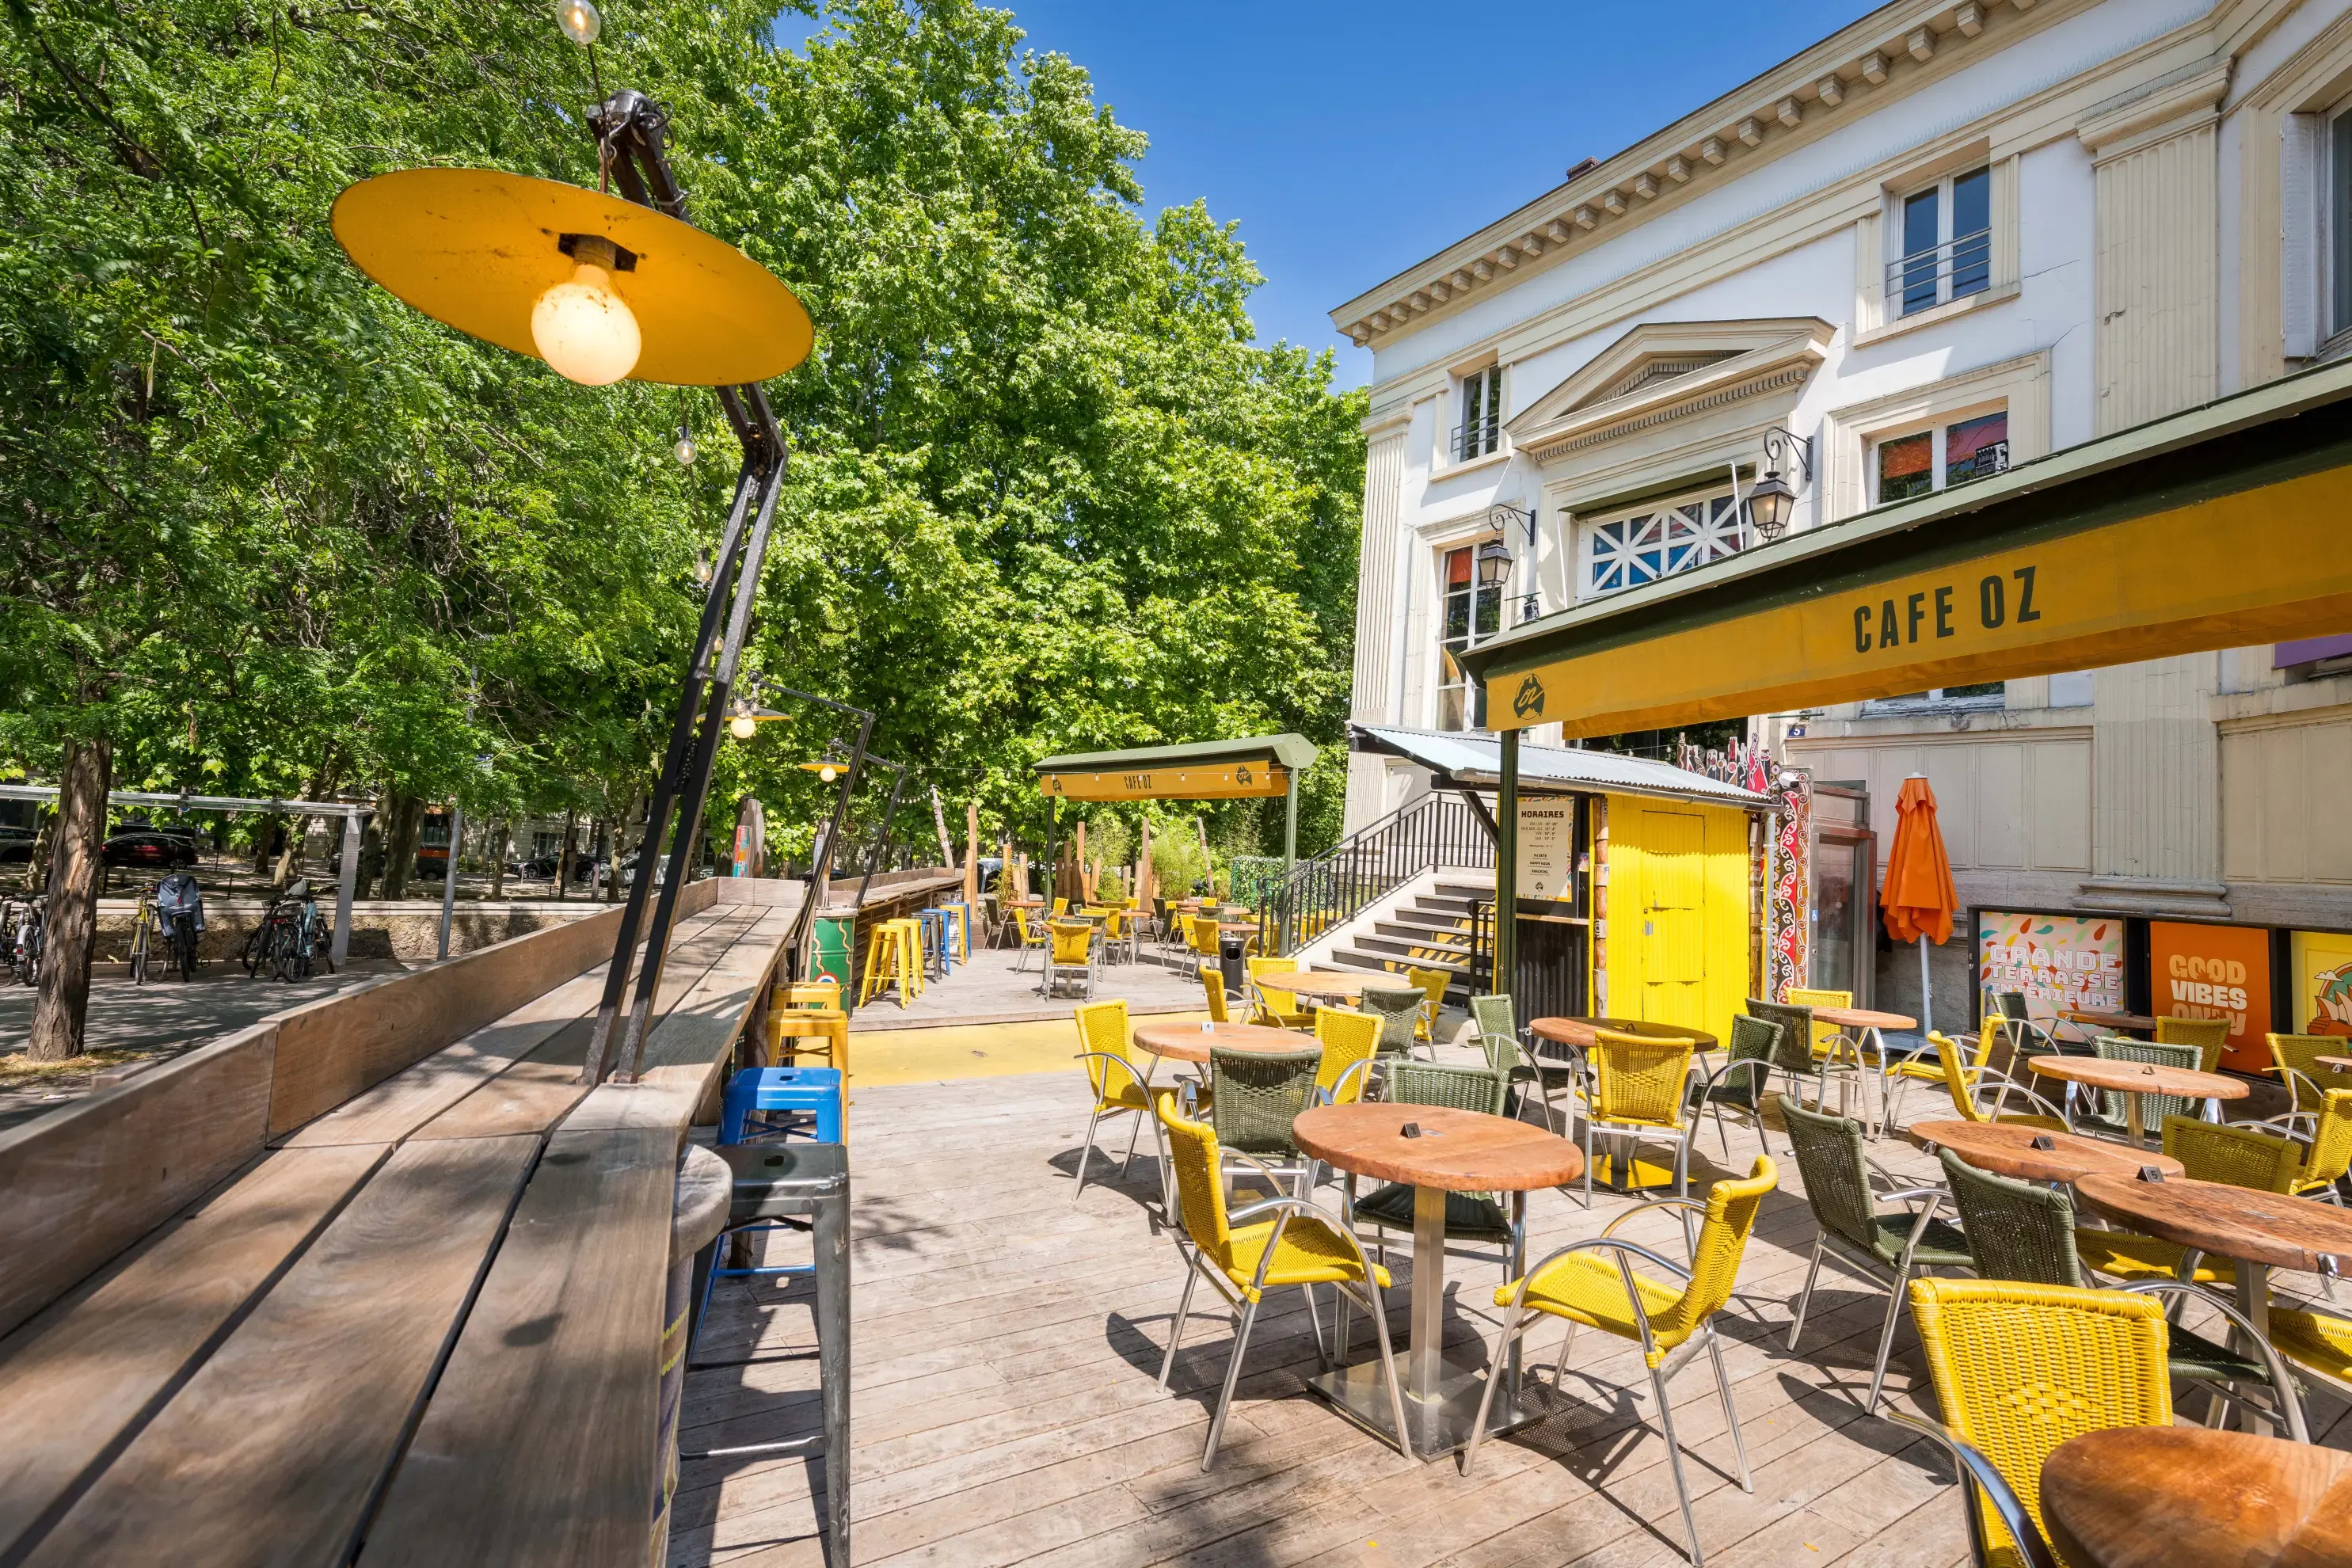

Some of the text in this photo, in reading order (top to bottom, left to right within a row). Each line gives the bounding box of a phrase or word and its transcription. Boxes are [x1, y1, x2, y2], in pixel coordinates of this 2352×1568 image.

[1854, 565, 2041, 653] CAFE OZ
[1124, 774, 1152, 790] CAFE OZ
[1520, 810, 1565, 819] HORAIRES
[1989, 945, 2118, 973] GRANDE
[2168, 954, 2247, 985] GOOD
[1989, 964, 2119, 991] TERRASSE
[2170, 979, 2247, 1010] VIBES
[1410, 1127, 1418, 1136] 3
[2043, 1139, 2050, 1147] 6
[2150, 1170, 2158, 1180] 5
